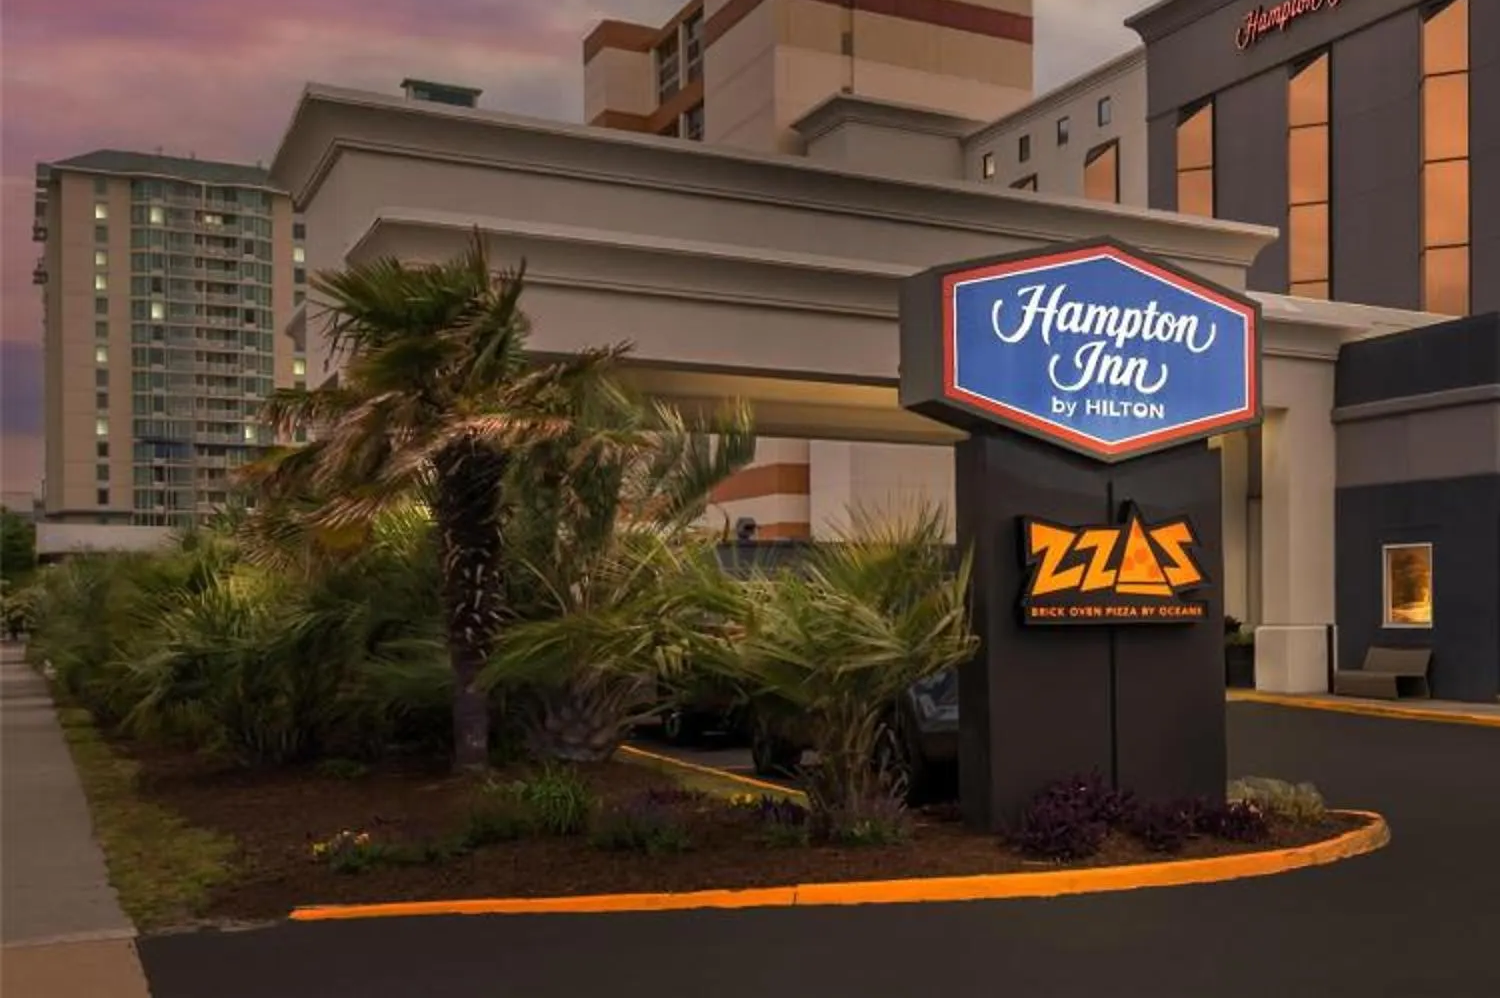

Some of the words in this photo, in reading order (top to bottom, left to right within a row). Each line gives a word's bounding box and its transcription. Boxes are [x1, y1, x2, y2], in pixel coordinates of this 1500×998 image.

[991, 283, 1217, 353] Hampton
[1049, 341, 1167, 395] Inn
[1052, 397, 1078, 416] by
[1086, 399, 1165, 419] HILTON
[1030, 515, 1202, 597] ZZAS
[1031, 605, 1065, 618] BRICK
[1069, 605, 1102, 618] OVEN
[1105, 605, 1138, 618] PIZZA
[1141, 605, 1156, 618] BY
